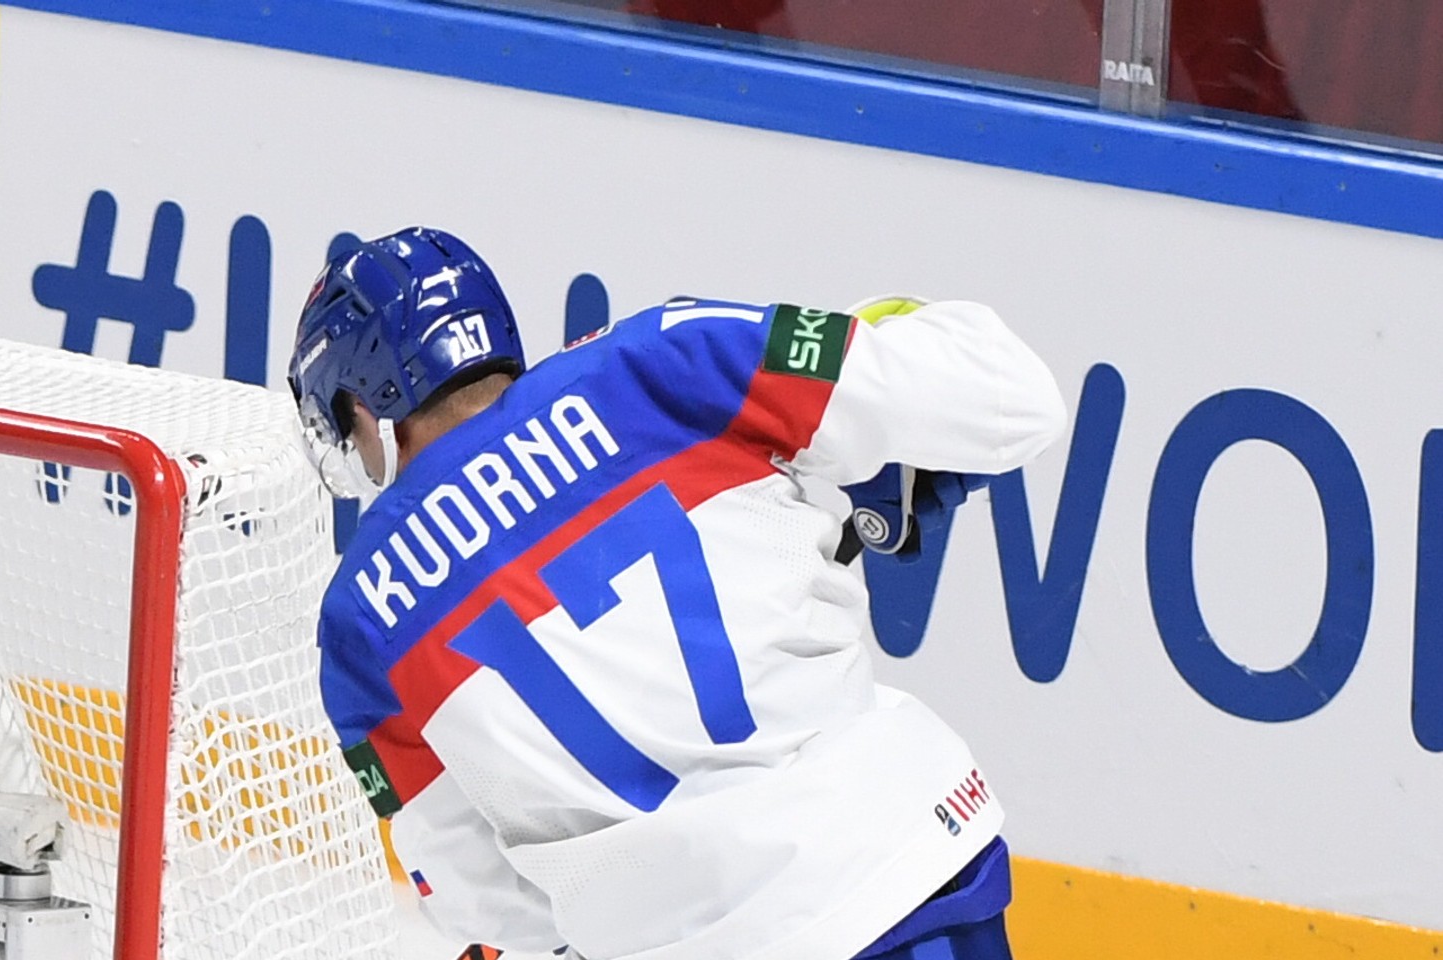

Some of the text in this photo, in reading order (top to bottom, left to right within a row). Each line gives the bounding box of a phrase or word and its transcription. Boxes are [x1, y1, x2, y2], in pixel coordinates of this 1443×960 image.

[1103, 59, 1155, 86] RAITA
[447, 313, 492, 366] 17
[354, 394, 621, 629] KUDRNA
[446, 480, 759, 813] 17
